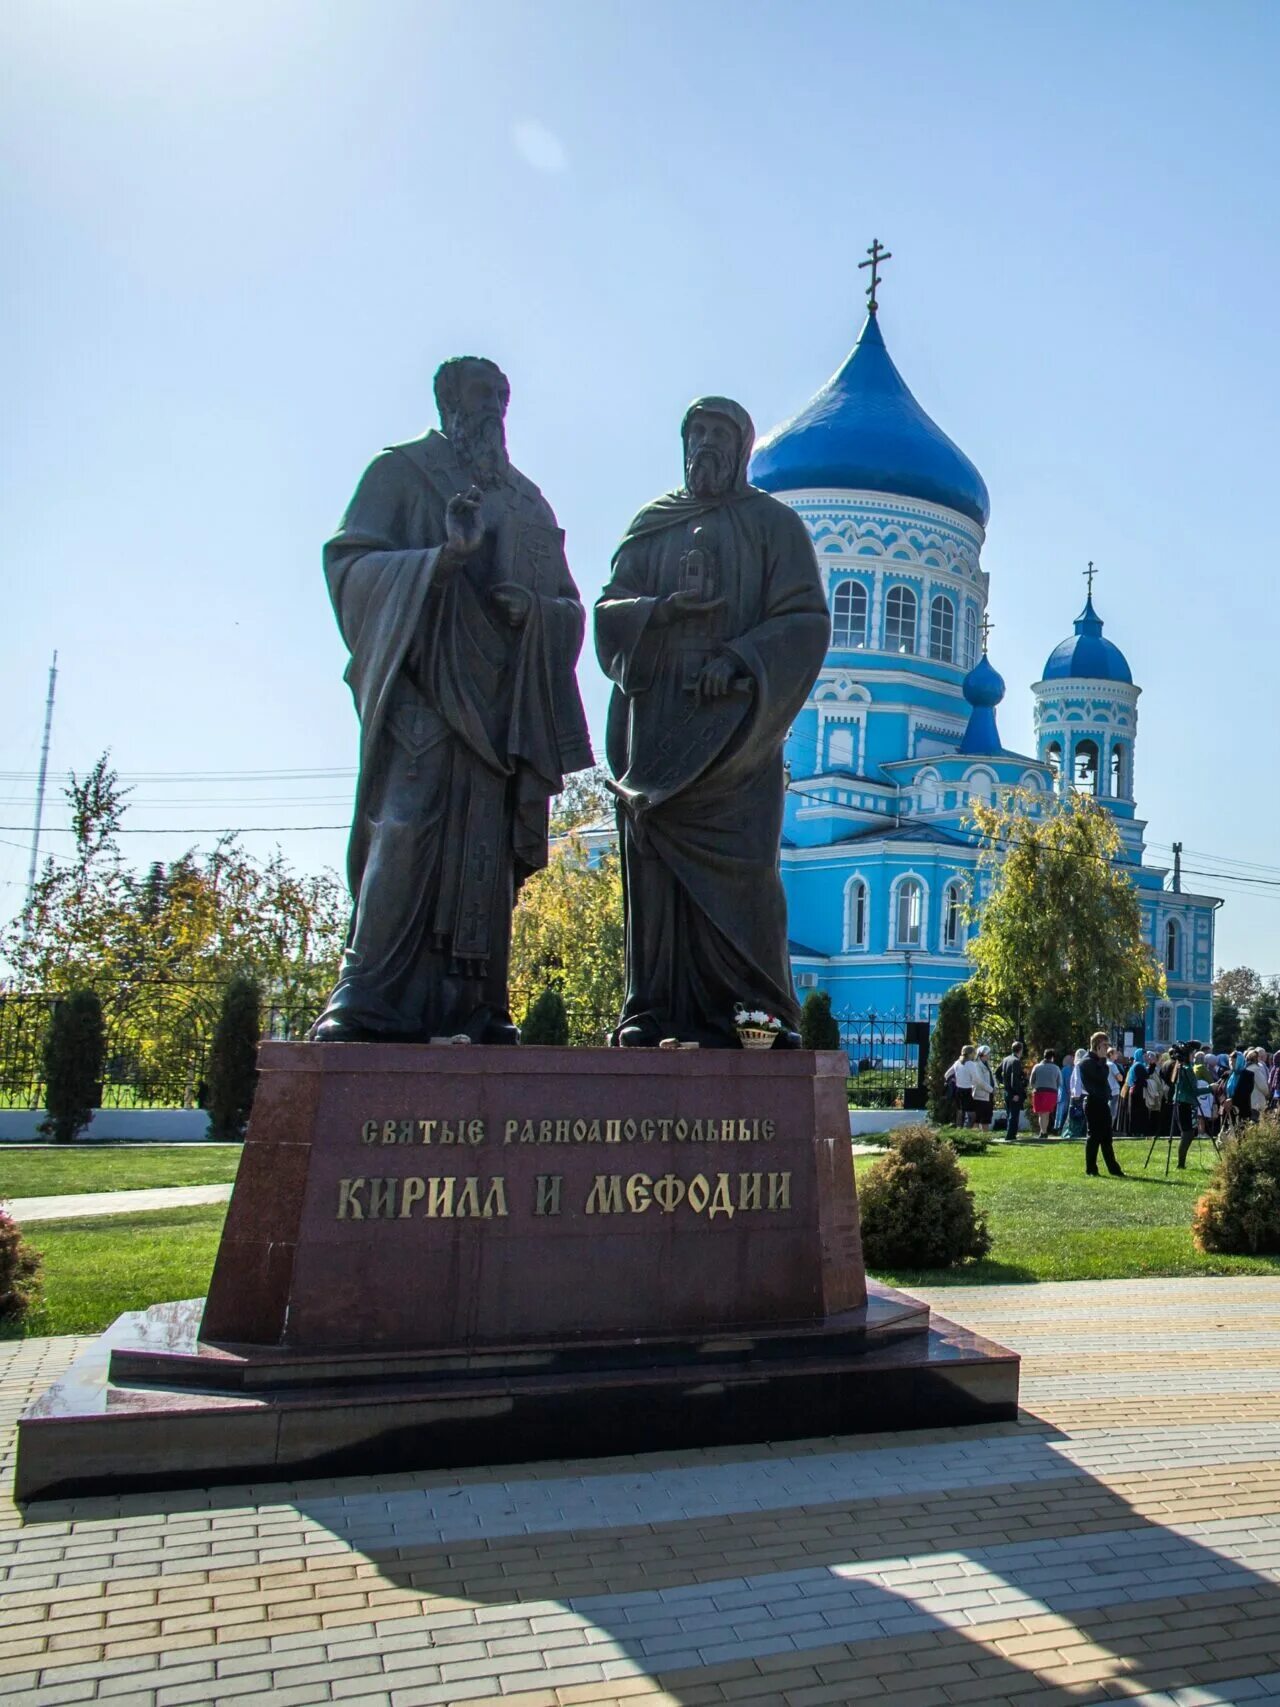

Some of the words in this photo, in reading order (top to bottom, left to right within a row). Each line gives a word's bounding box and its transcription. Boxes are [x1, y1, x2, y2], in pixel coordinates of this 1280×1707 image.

[361, 1118, 485, 1145] СВЯТЫЕ
[503, 1118, 776, 1145] РАВНОАПОСТОЛЬНЫЕ
[335, 1175, 509, 1220] КИРИЛЛ
[533, 1175, 564, 1217] И
